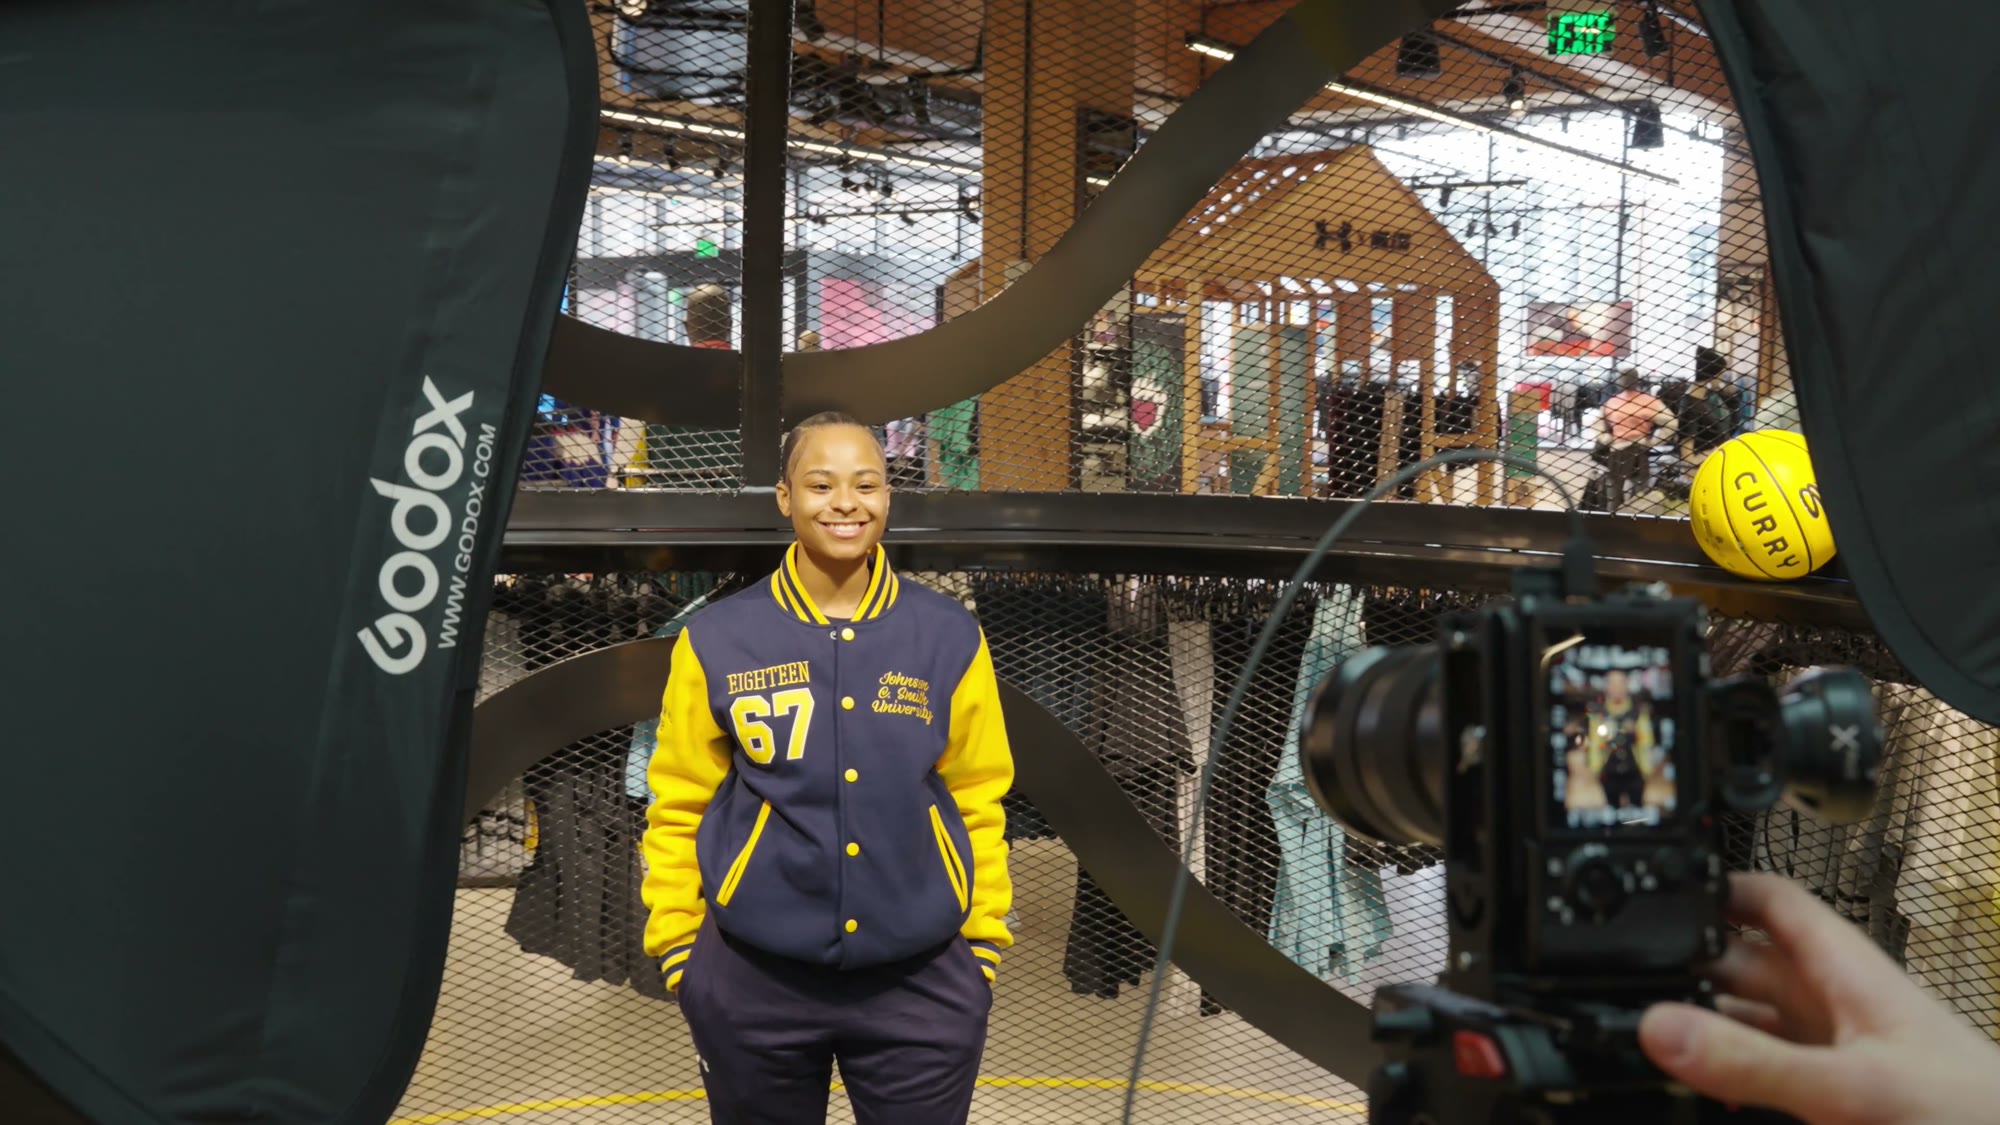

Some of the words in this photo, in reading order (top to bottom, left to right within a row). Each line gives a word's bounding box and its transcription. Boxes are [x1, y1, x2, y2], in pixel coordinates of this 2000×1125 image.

[438, 423, 496, 649] WWW.GODOX.COM
[1735, 472, 1800, 568] CURRY
[727, 661, 810, 693] EIGHTEEN
[879, 671, 929, 691] Johnson
[871, 700, 933, 725] University
[897, 687, 929, 706] Smith
[729, 689, 815, 763] 67
